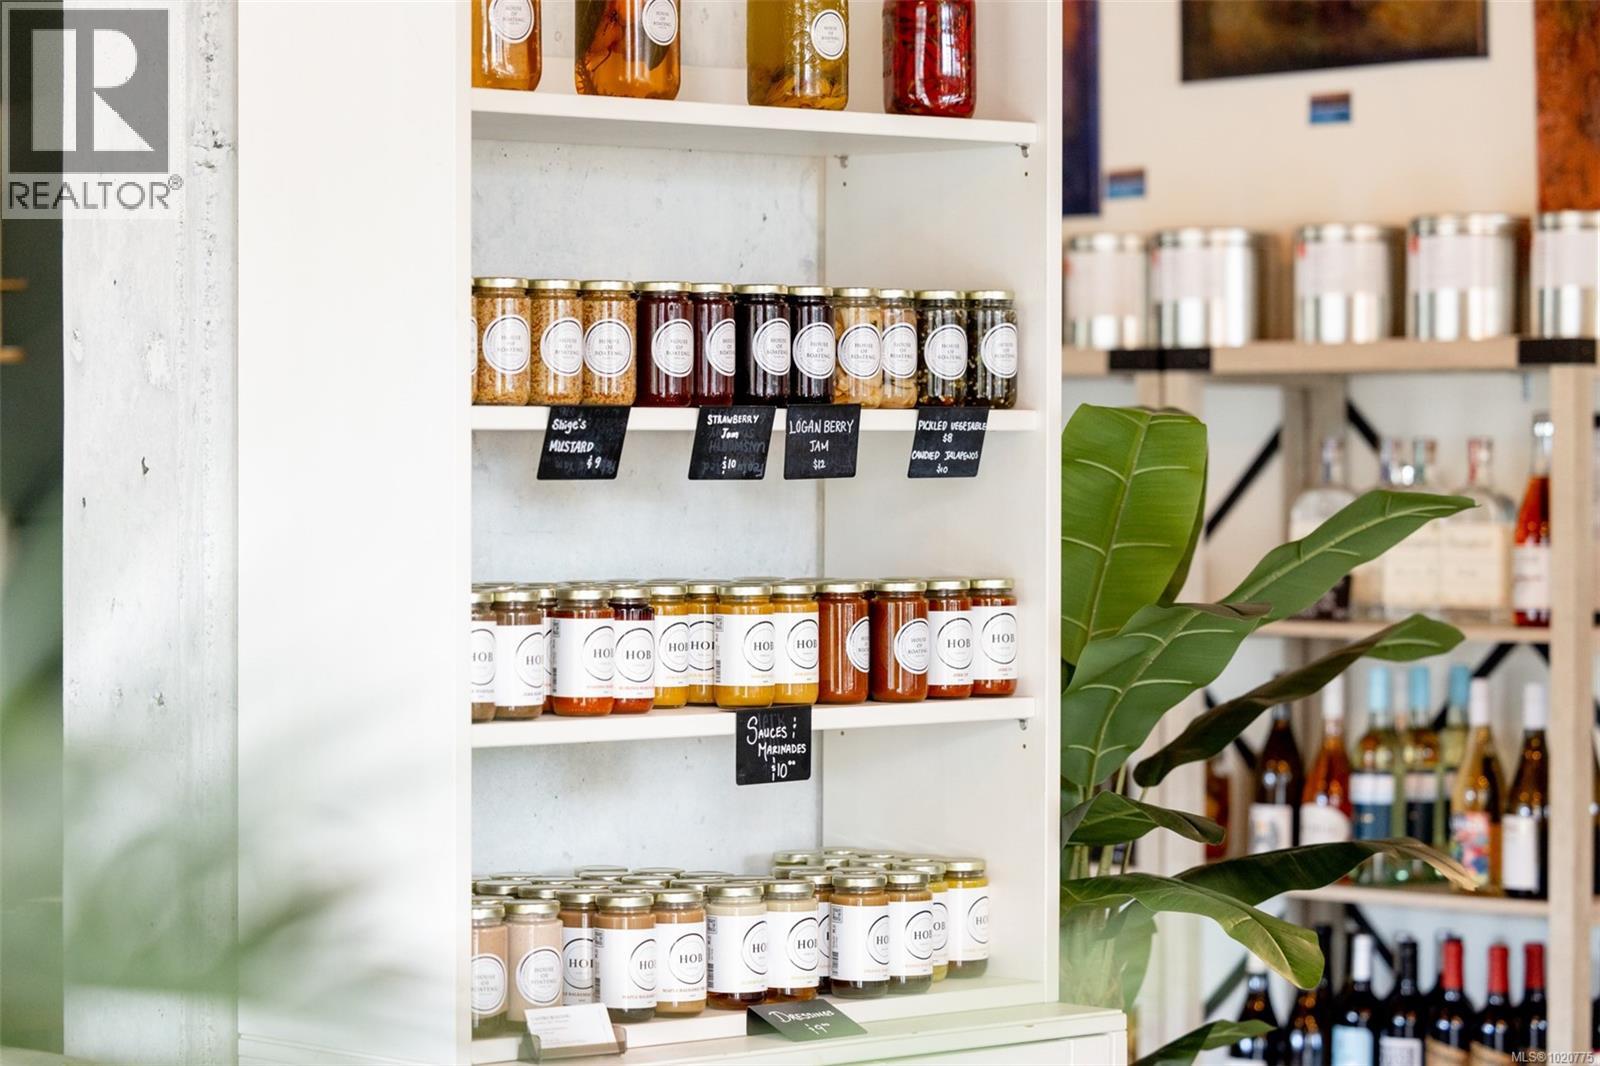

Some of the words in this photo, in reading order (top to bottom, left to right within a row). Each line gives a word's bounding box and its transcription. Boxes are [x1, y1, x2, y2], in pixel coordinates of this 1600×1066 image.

[707, 414, 760, 426] STRAWBERRY
[918, 419, 948, 431] PICKLED
[942, 432, 953, 443] $8
[548, 439, 595, 454] MUSTARD
[809, 440, 830, 453] JAM
[911, 450, 940, 460] CANDIED
[721, 456, 737, 475] $10
[812, 458, 826, 471] $12
[936, 463, 949, 474] $10
[947, 639, 971, 648] HOB
[992, 634, 1015, 643] HOB
[626, 650, 651, 660] HOB
[933, 922, 945, 930] OB
